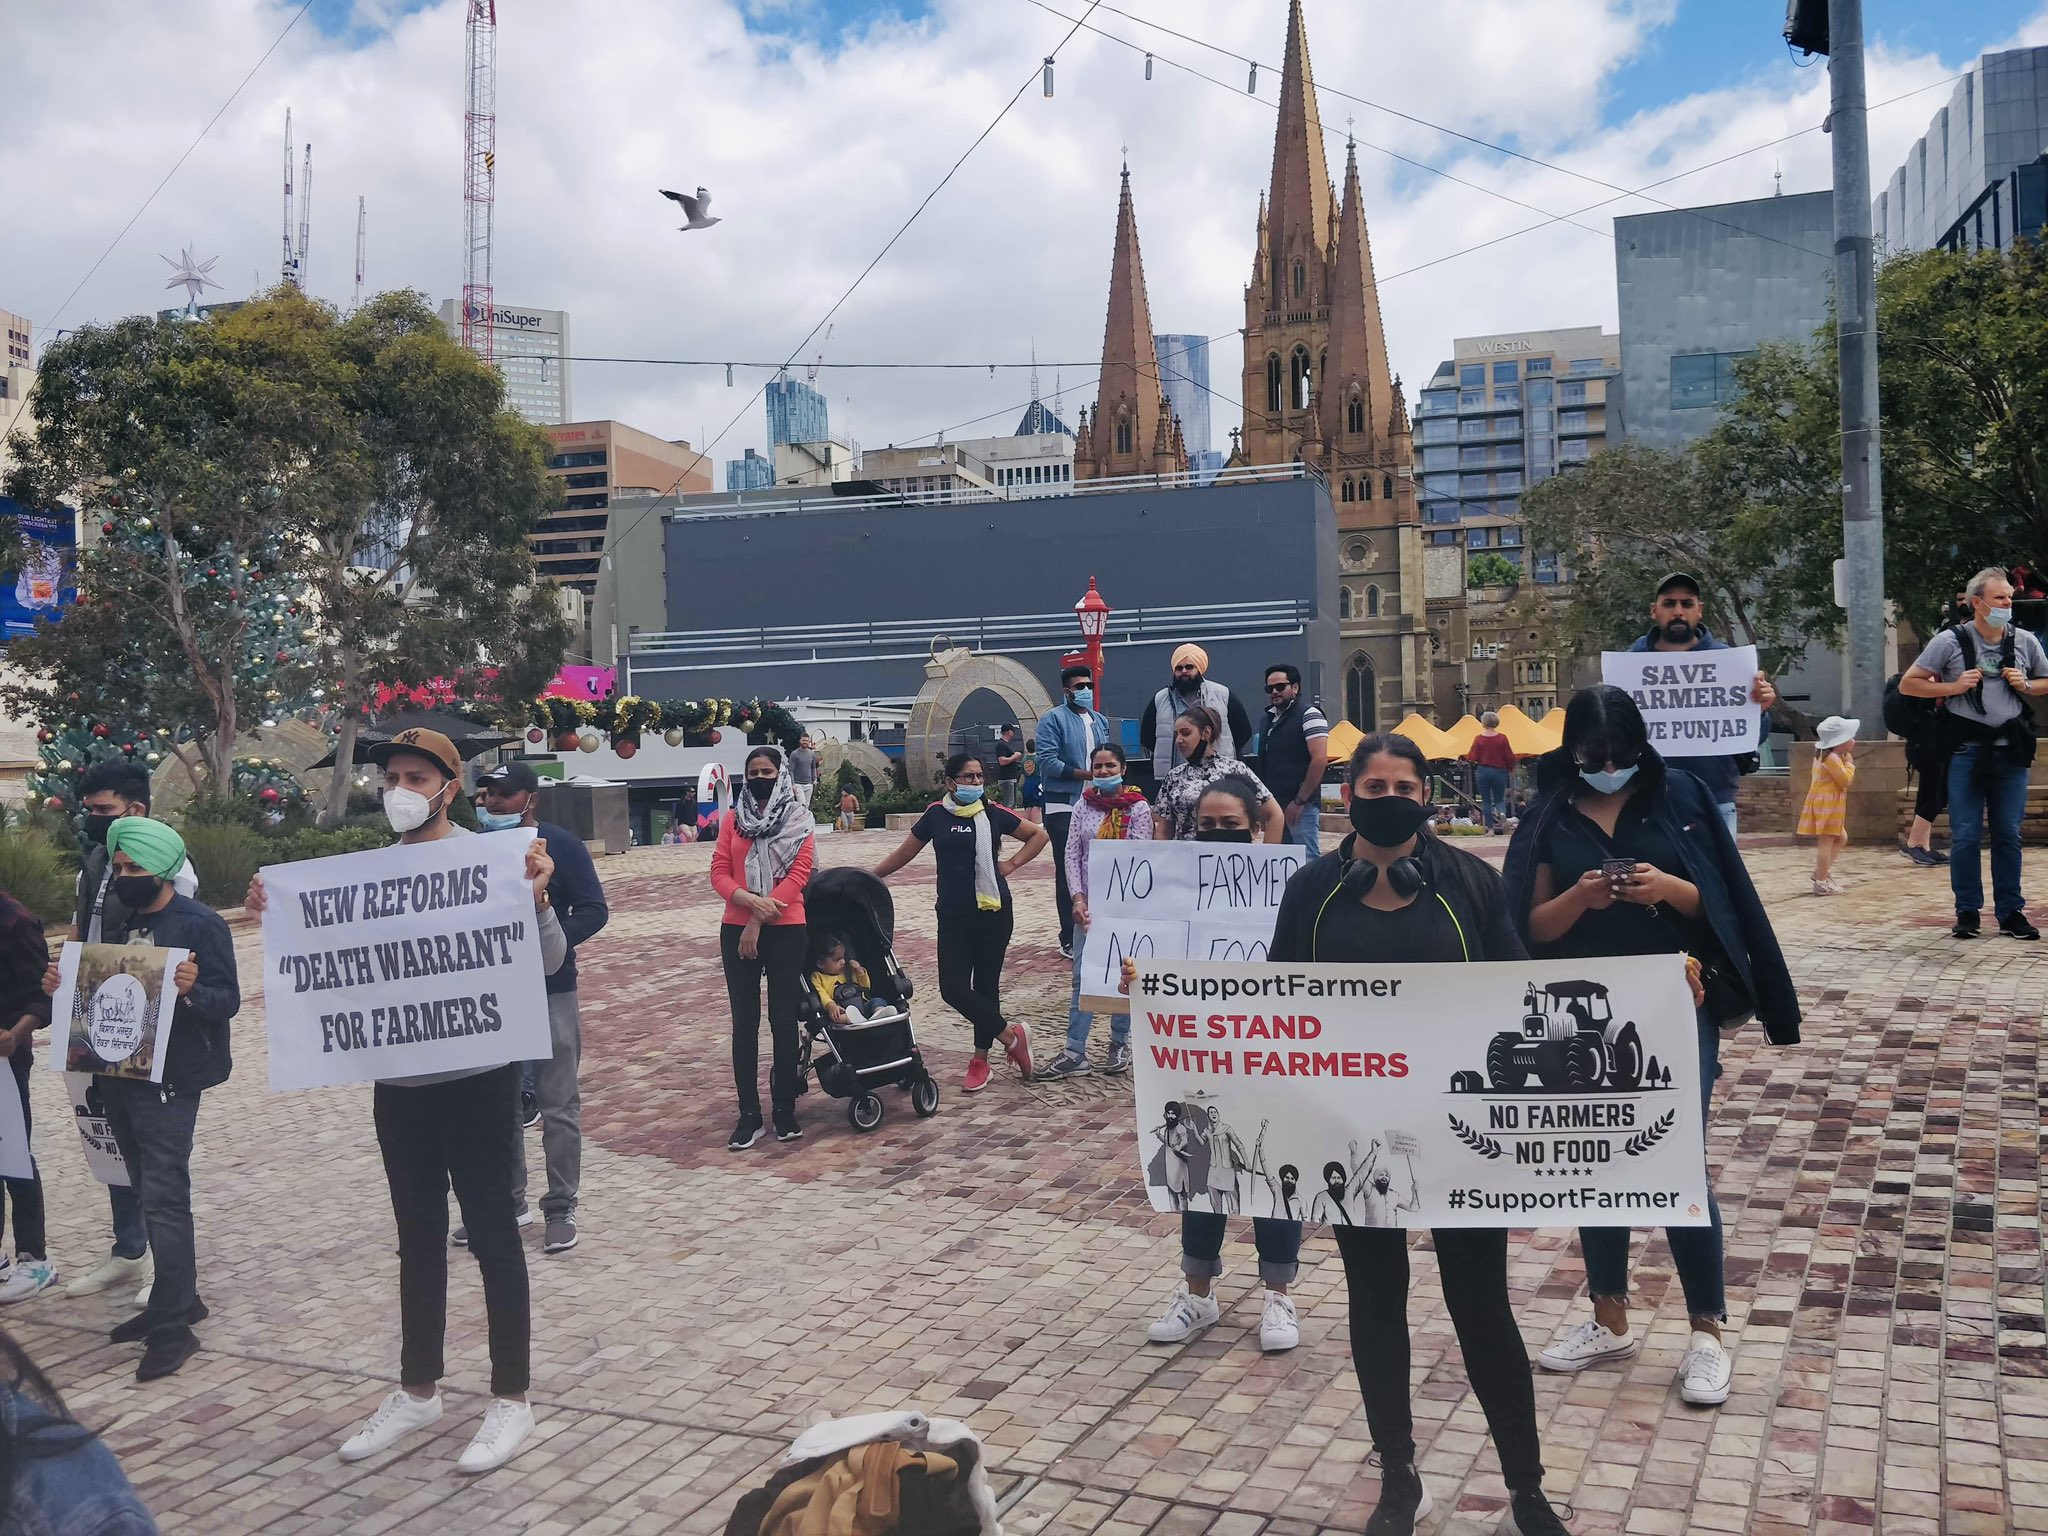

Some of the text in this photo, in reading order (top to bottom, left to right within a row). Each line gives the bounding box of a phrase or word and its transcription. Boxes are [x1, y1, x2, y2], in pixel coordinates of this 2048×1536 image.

[481, 308, 542, 328] UniSuper
[1476, 340, 1532, 354] WESTIN
[17, 513, 31, 521] OUR
[1642, 664, 1717, 686] SAVE
[1625, 685, 1747, 710] ARMERS
[1645, 718, 1747, 743] VE PUNJAB
[950, 825, 972, 833] FILA
[1106, 856, 1153, 901] NO
[299, 864, 488, 929] NEW REFORMS
[1141, 973, 1402, 1001] #SupportFarmer
[321, 992, 502, 1053] FOR FARMERS
[1146, 1011, 1322, 1040] WE STAND
[1150, 1045, 1409, 1078] WITH FARMERS
[1489, 1103, 1635, 1129] NO FARMERS
[92, 1122, 104, 1136] NO
[105, 1141, 118, 1155] NO
[1516, 1139, 1611, 1164] NO FOOD
[1448, 1188, 1680, 1213] #SupportFarmer
